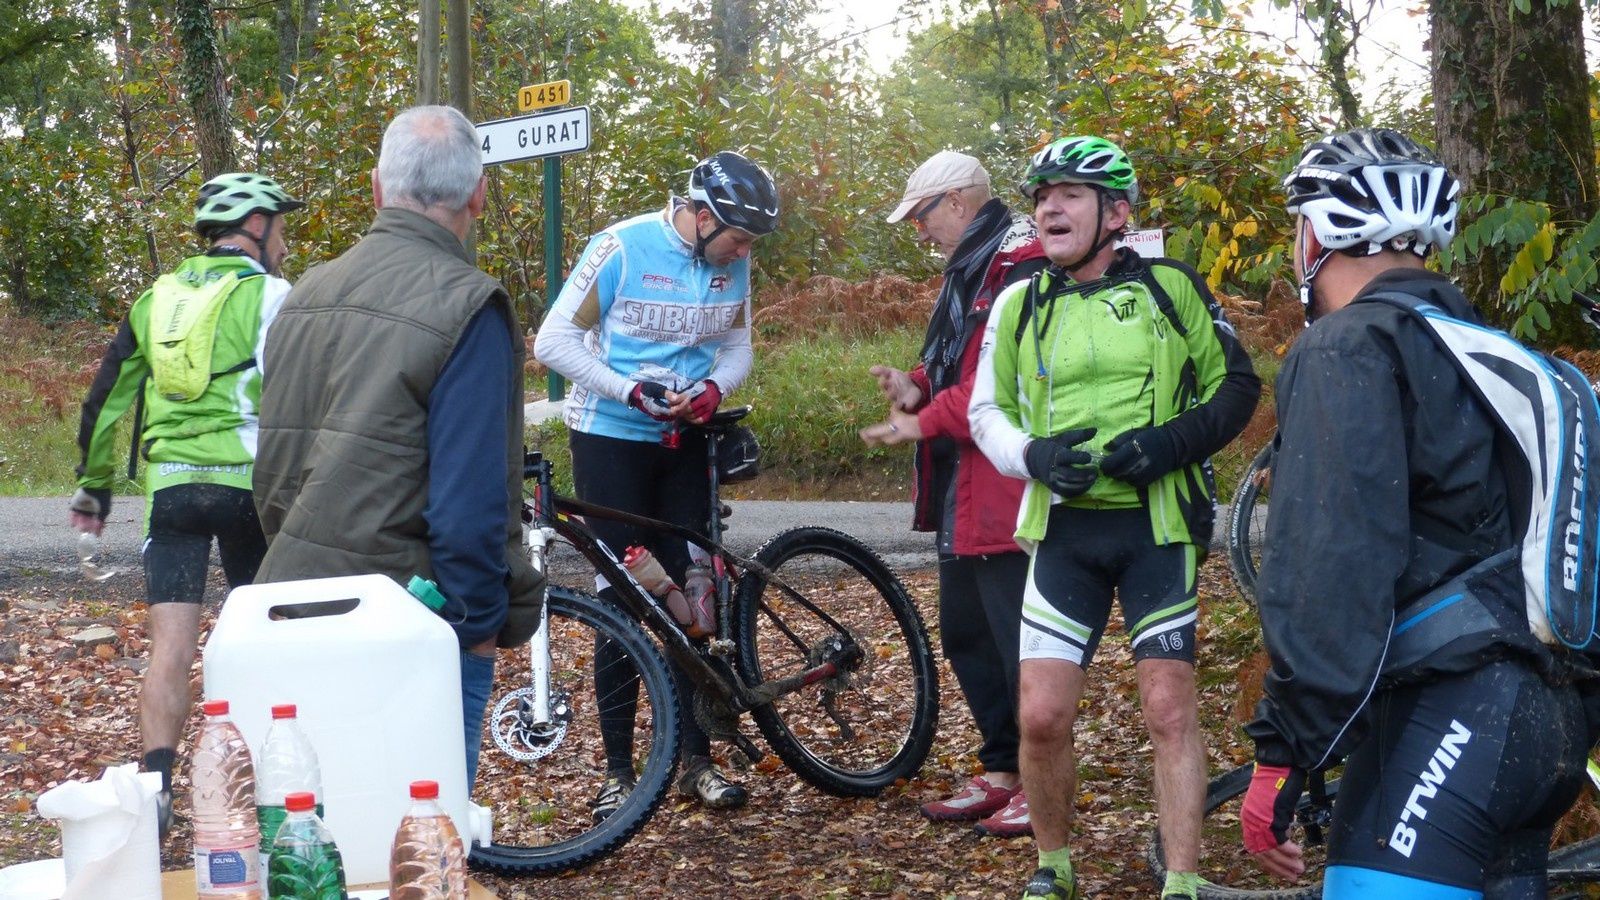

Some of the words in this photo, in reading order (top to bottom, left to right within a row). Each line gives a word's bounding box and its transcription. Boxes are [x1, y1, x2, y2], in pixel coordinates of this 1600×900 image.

[524, 91, 532, 107] D
[537, 84, 565, 103] 451
[518, 119, 580, 148] GURAT
[573, 234, 620, 292] ACS
[1158, 631, 1184, 653] 16
